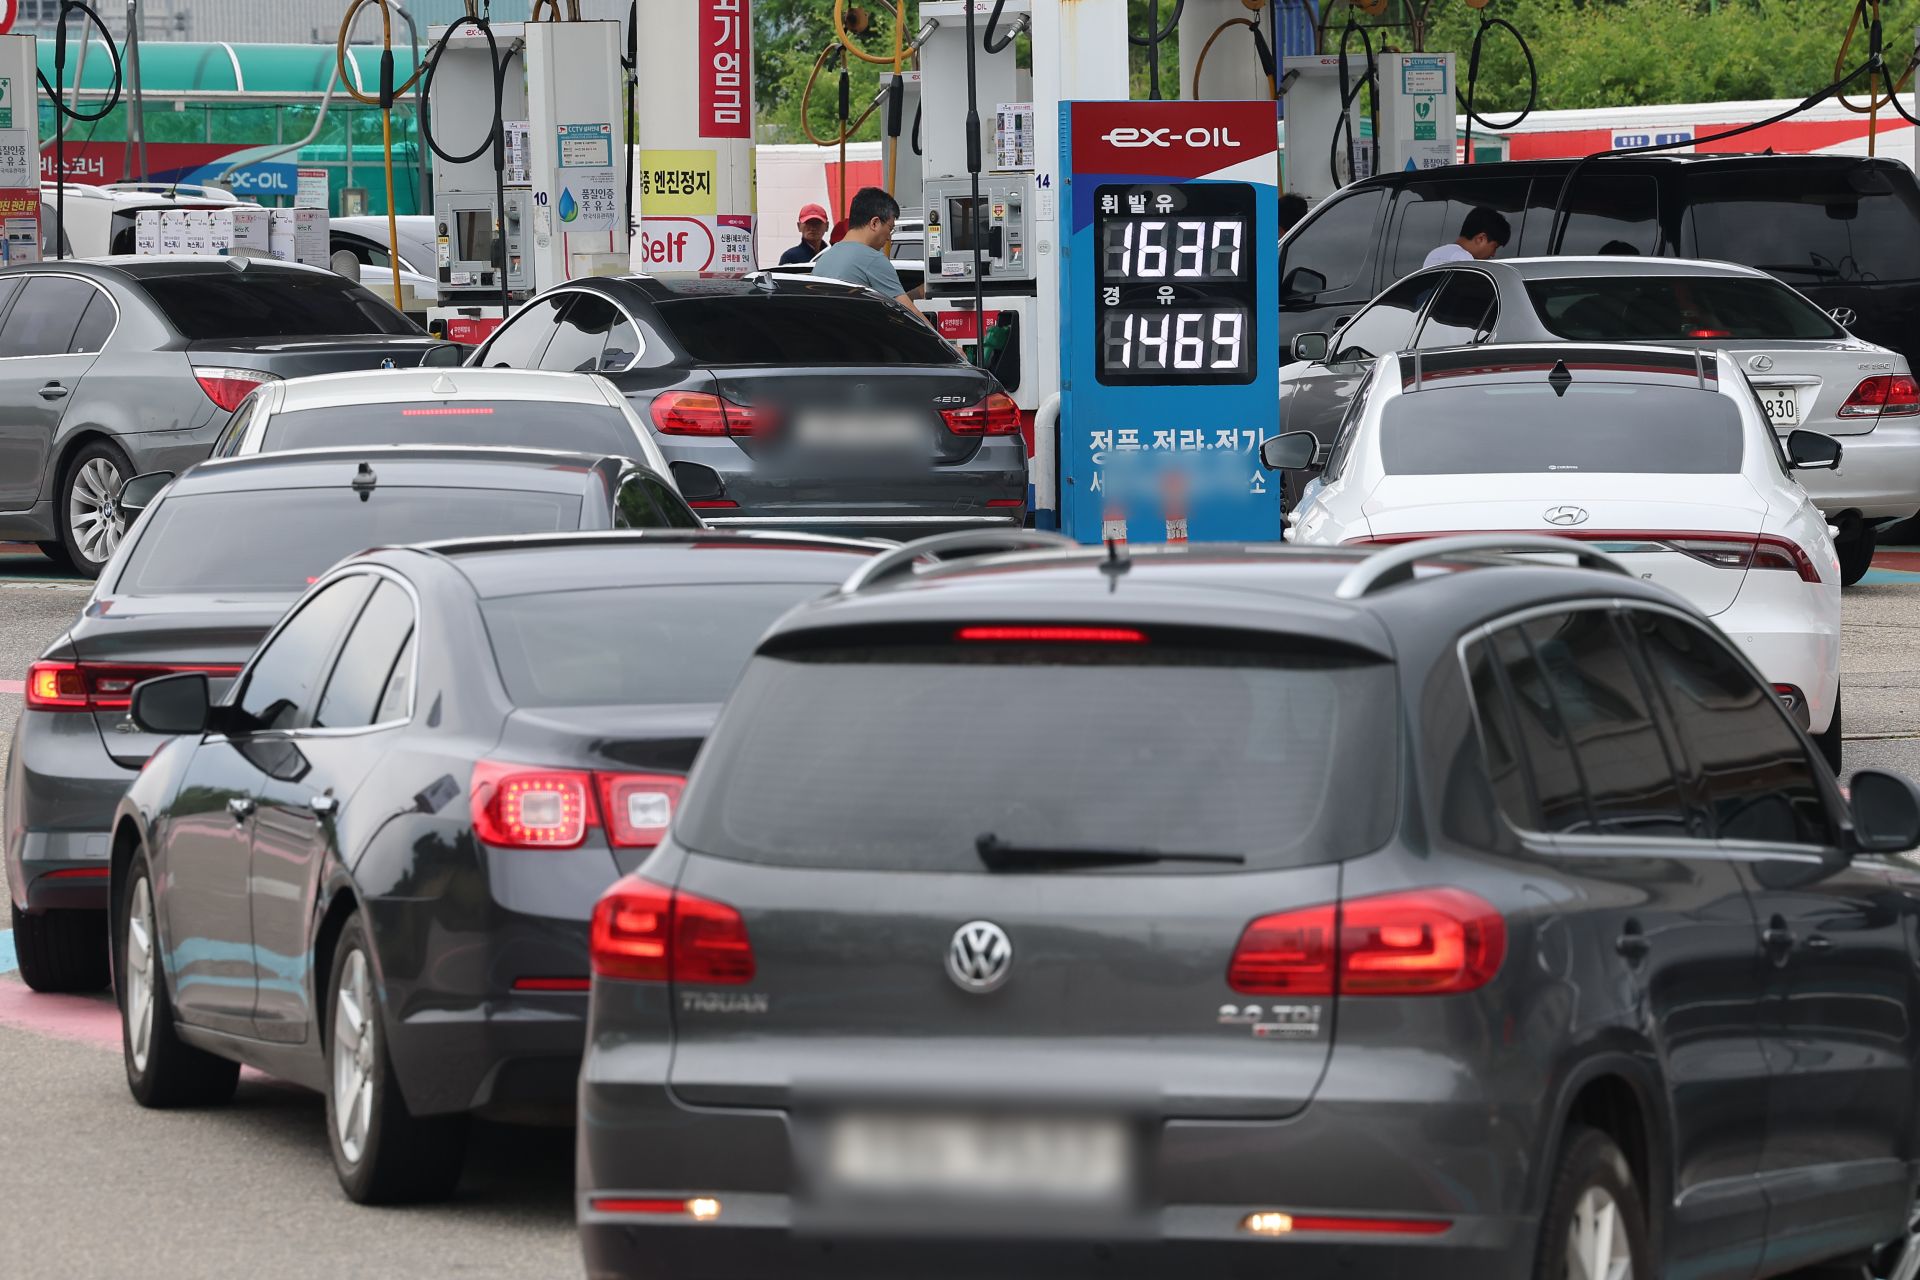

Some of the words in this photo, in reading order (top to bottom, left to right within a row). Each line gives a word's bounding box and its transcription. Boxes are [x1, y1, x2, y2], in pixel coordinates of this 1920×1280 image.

[1101, 127, 1241, 147] ex-OIL
[0, 145, 26, 155] 질인증
[654, 170, 710, 195] 엔진정지
[1036, 174, 1050, 188] 14
[534, 192, 547, 205] 10
[581, 189, 614, 199] 품질인증
[642, 232, 688, 263] Self
[1121, 221, 1242, 277] 1637
[1121, 313, 1242, 368] 1469
